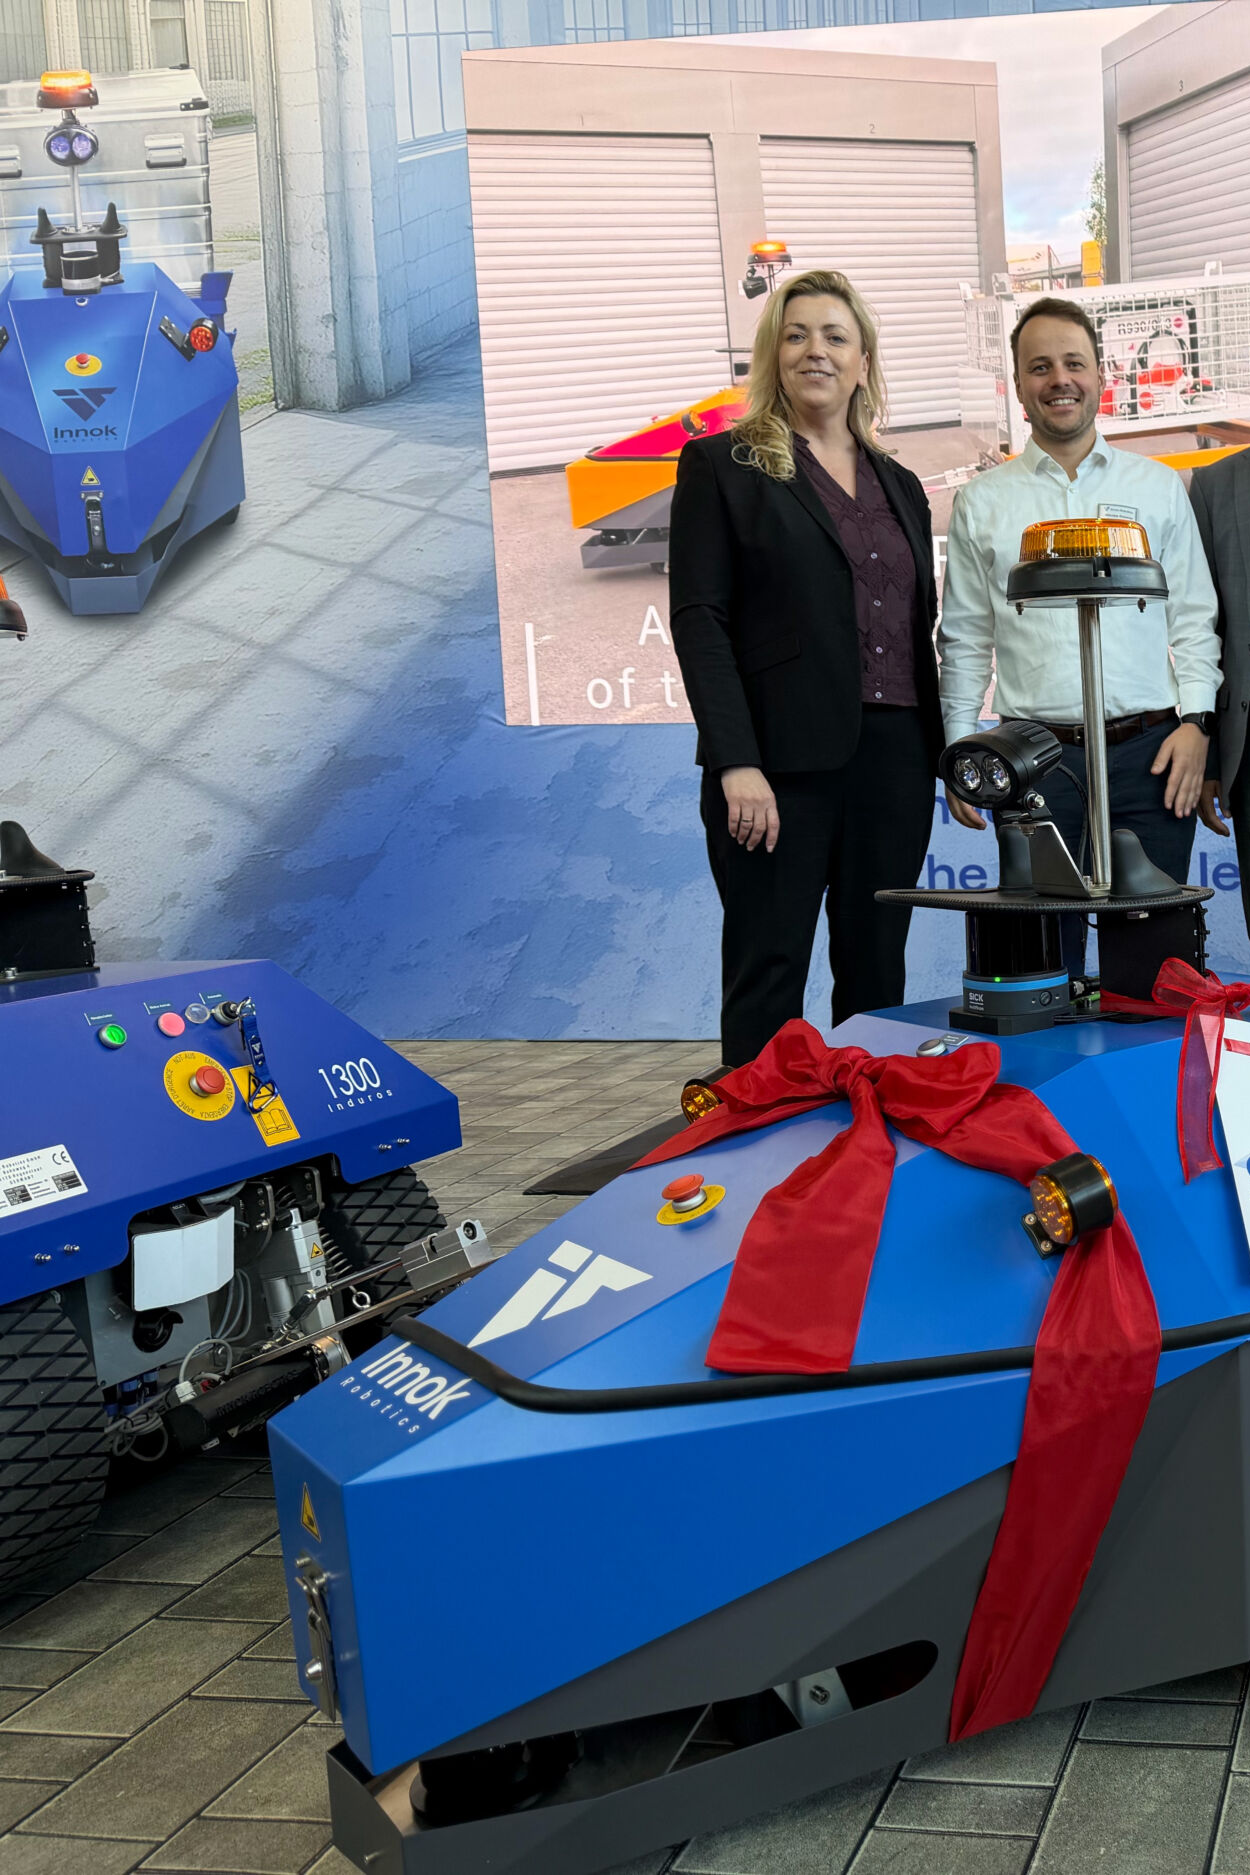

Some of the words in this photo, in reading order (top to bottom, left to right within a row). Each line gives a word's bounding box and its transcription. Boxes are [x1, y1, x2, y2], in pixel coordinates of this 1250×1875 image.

[53, 425, 118, 439] Innok
[586, 666, 636, 709] of
[916, 854, 988, 890] he
[968, 992, 984, 1002] SICK
[318, 1057, 381, 1099] 1300
[327, 1089, 393, 1113] Induros
[360, 1341, 472, 1421] Innok
[339, 1376, 420, 1434] Robotics
